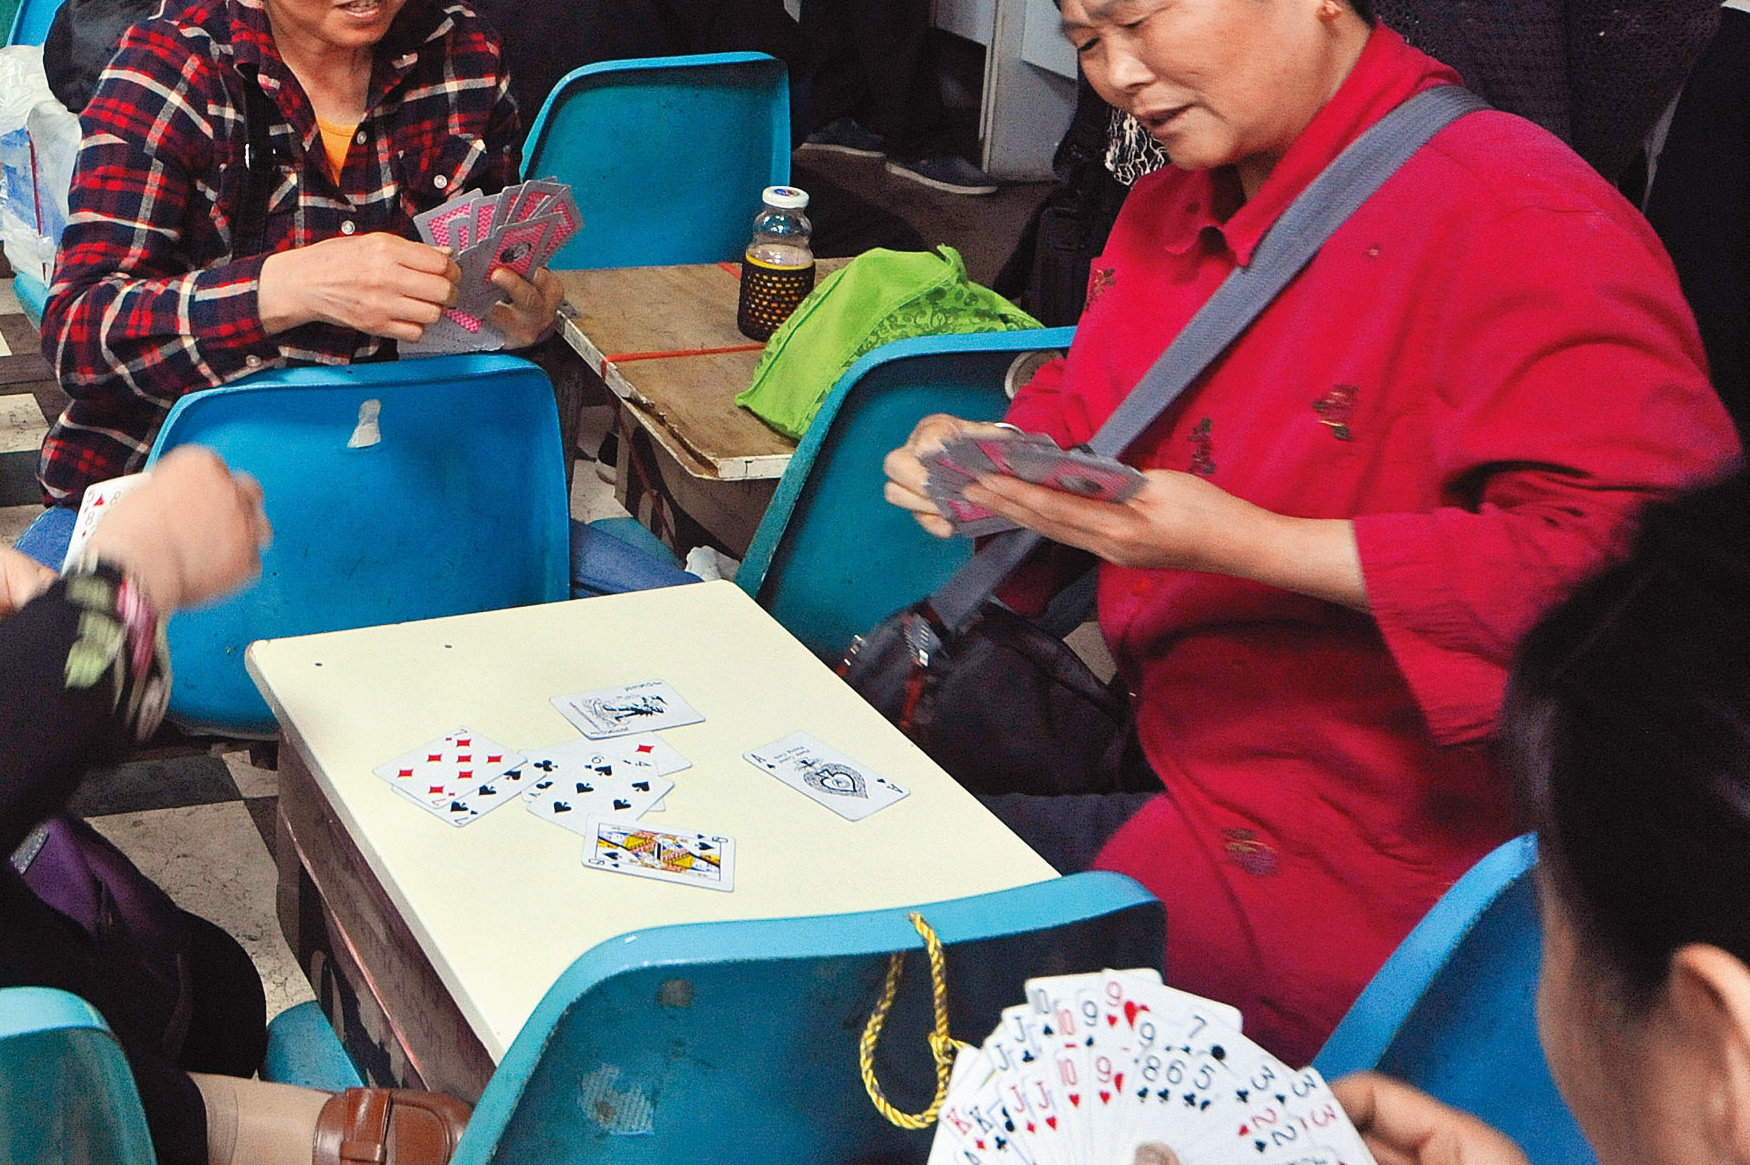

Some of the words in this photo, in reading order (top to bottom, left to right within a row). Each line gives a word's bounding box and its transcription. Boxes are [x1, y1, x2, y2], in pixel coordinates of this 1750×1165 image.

[750, 753, 766, 764] A
[886, 783, 904, 794] A
[1106, 981, 1123, 1007] 9
[1082, 999, 1098, 1027] 9
[1014, 1015, 1026, 1042] J
[1139, 1022, 1156, 1048] 9
[1192, 1014, 1208, 1039] 7
[995, 1044, 1009, 1071] J
[1096, 1056, 1112, 1083] 9
[1142, 1055, 1161, 1082] 8
[1166, 1059, 1187, 1085] 6
[1193, 1064, 1217, 1091] 5
[1251, 1065, 1276, 1091] 3
[1035, 1081, 1049, 1109] J
[1291, 1074, 1317, 1098] 3
[1010, 1086, 1026, 1113] J
[969, 1106, 993, 1134] K
[1251, 1107, 1278, 1129] 2
[1310, 1103, 1337, 1128] 3
[1271, 1124, 1297, 1147] 2
